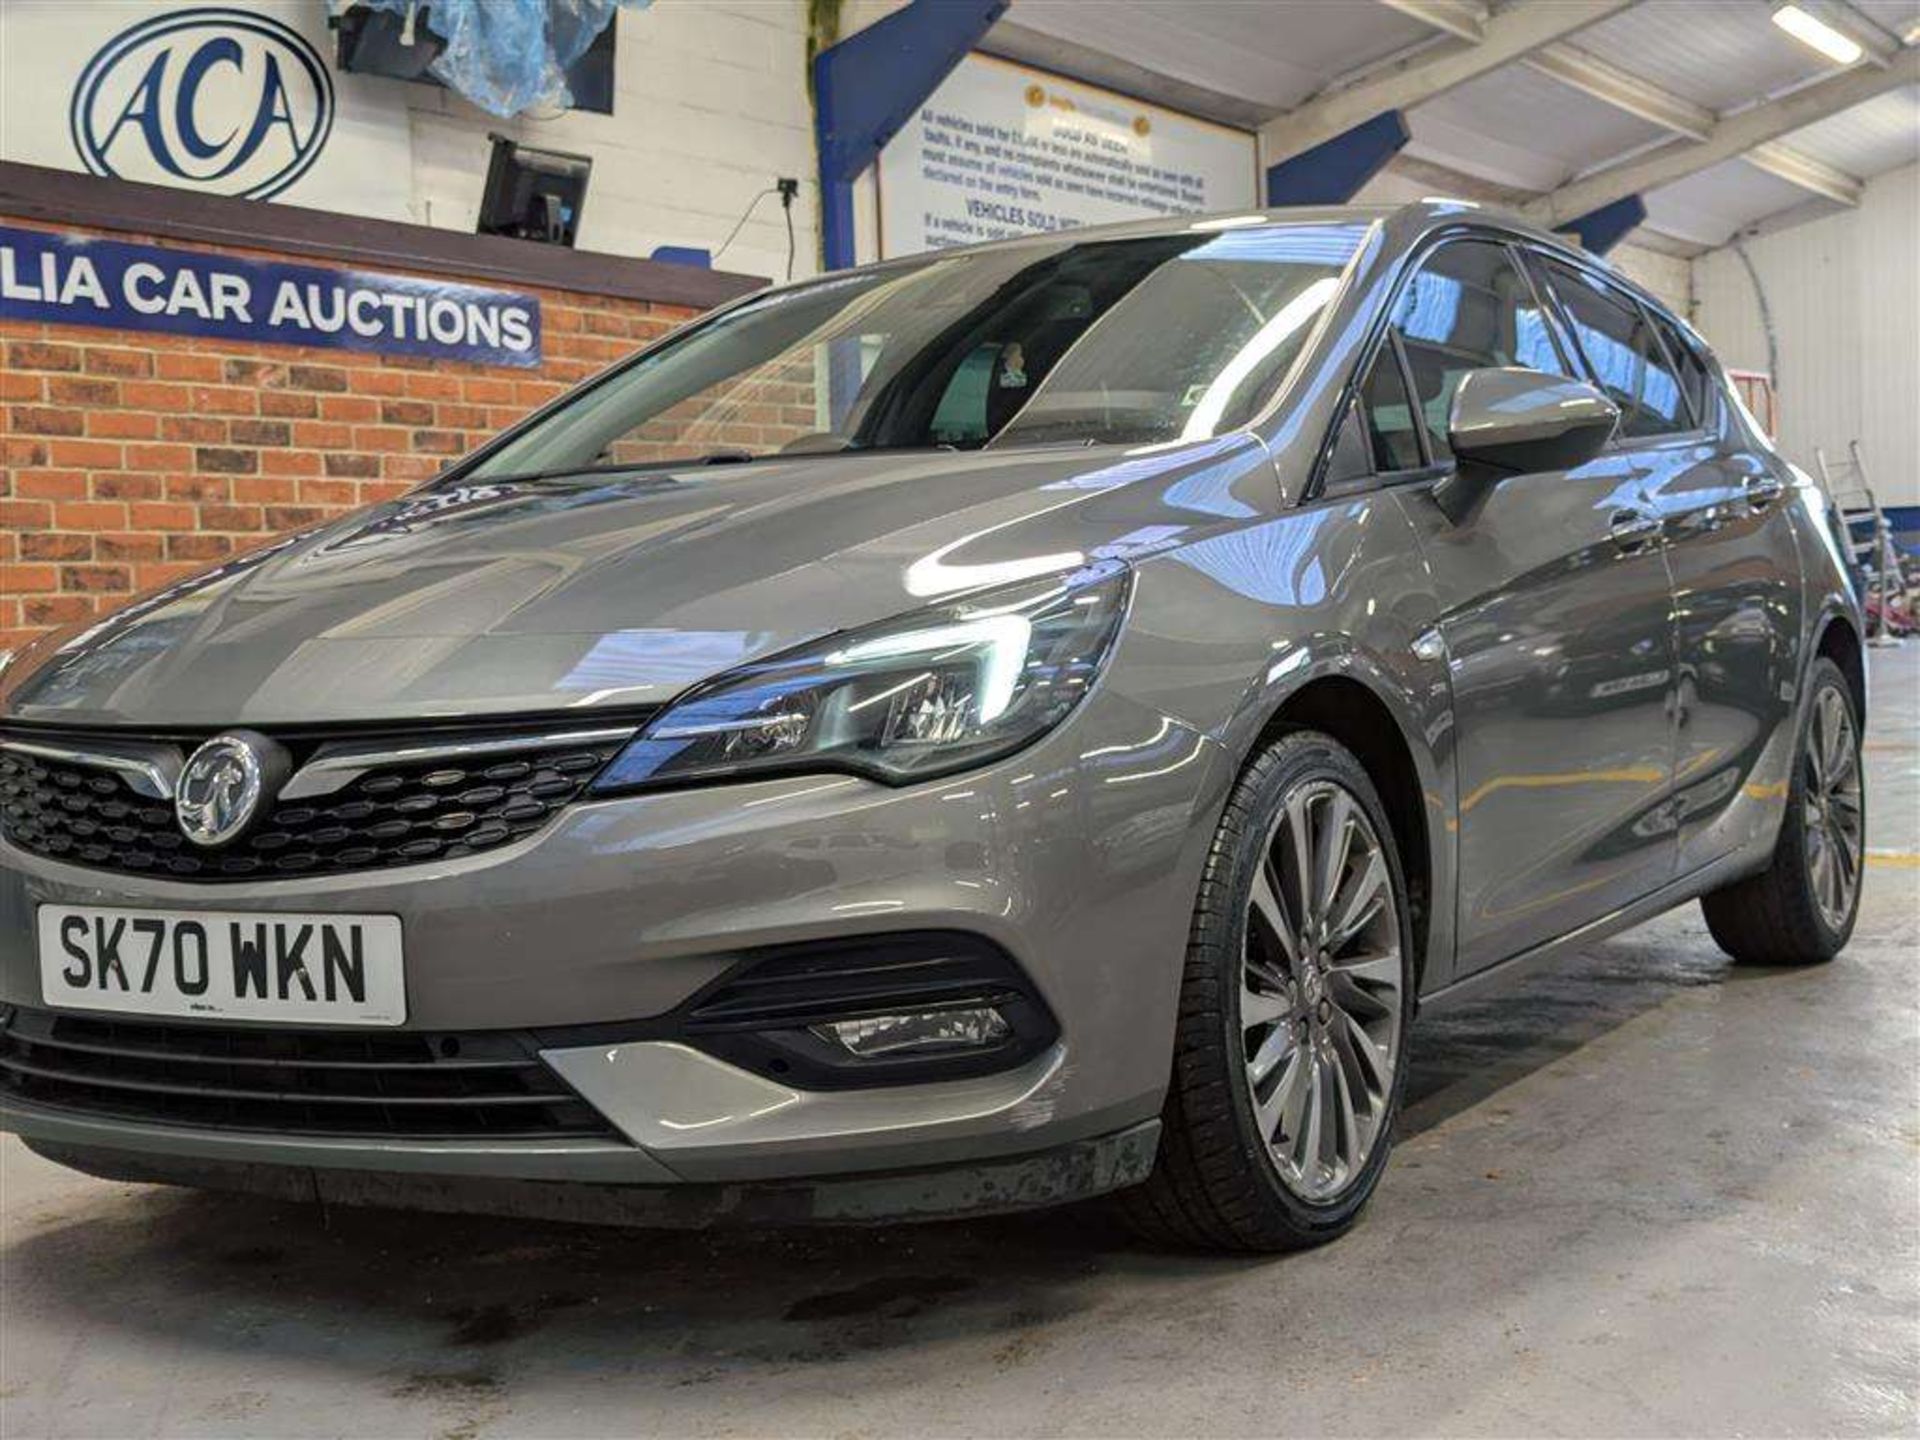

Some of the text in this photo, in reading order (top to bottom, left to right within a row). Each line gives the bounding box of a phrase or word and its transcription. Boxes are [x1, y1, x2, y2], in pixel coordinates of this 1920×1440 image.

[101, 36, 303, 181] ACA
[936, 111, 972, 132] vehicles
[984, 142, 1000, 158] and
[997, 163, 1033, 183] vehicles
[942, 218, 974, 235] vehicle
[966, 198, 1025, 226] VEHICLES
[1028, 210, 1056, 231] SOLD
[122, 261, 253, 324] CAR
[269, 281, 534, 354] AUCTIONS
[60, 915, 366, 1003] SK70 WKN
